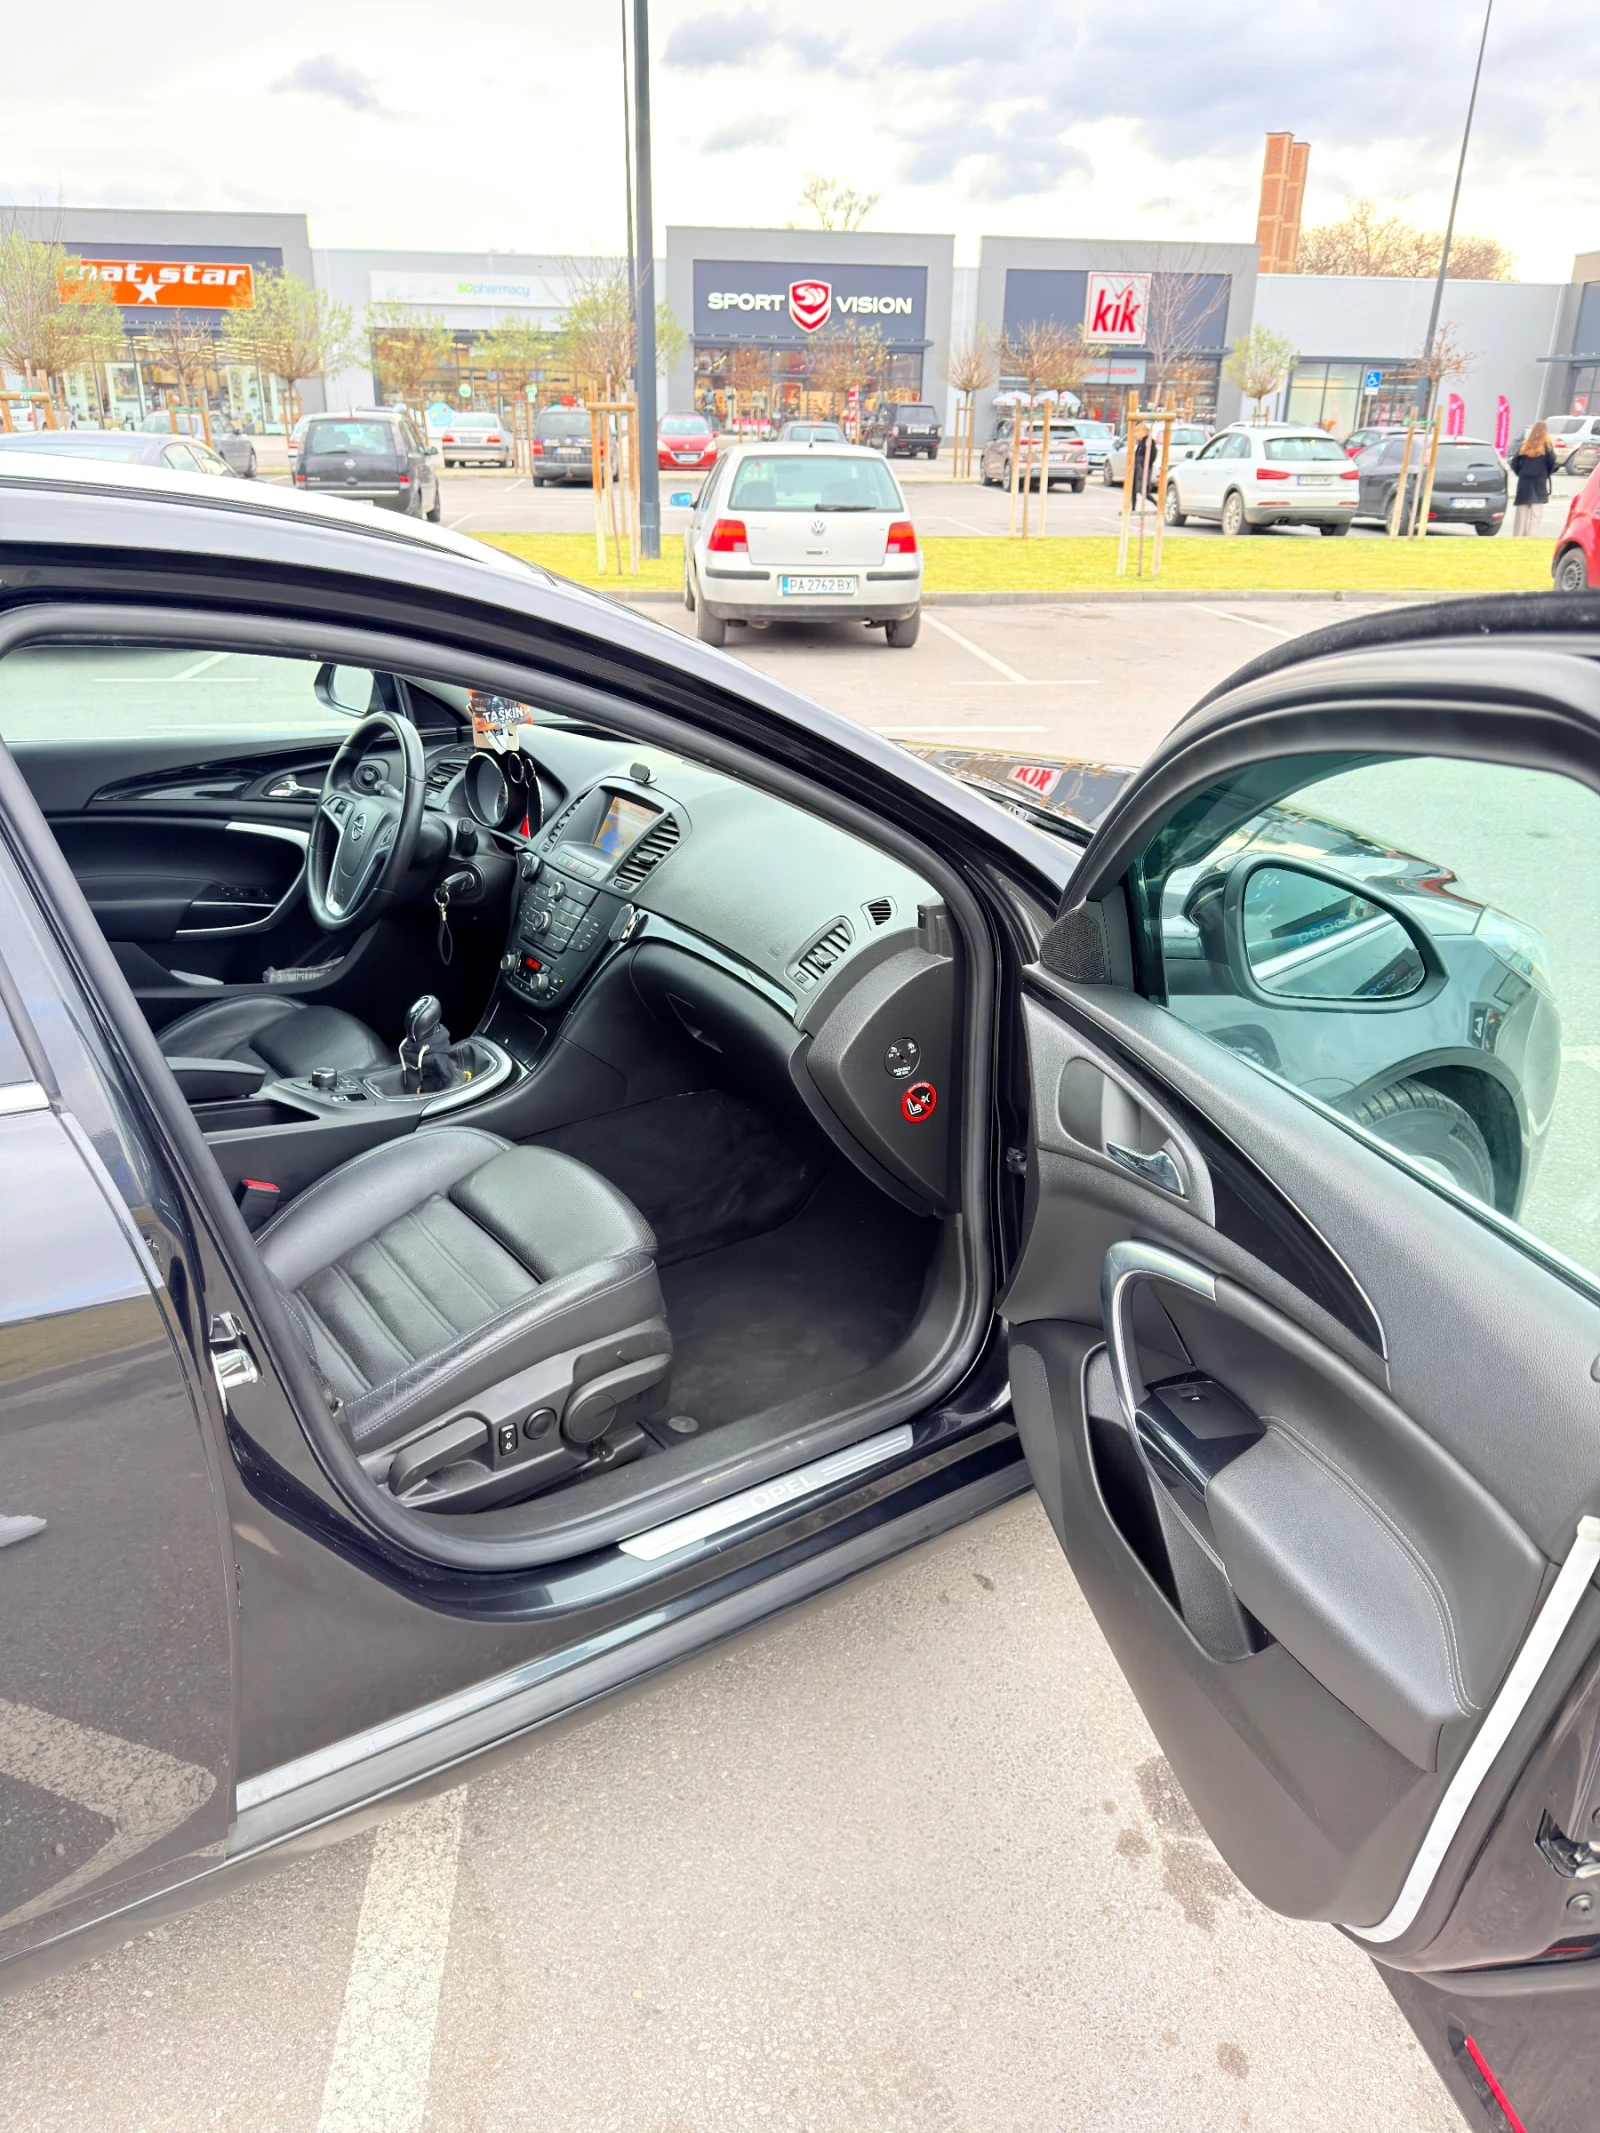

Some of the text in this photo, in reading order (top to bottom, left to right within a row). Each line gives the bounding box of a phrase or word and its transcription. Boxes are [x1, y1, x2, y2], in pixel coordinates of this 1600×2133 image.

[157, 265, 246, 286] star
[708, 292, 913, 314] SPORT VISION
[790, 579, 852, 591] PA 2762 BX
[1298, 913, 1358, 944] pepco
[750, 1476, 818, 1509] OPEL
